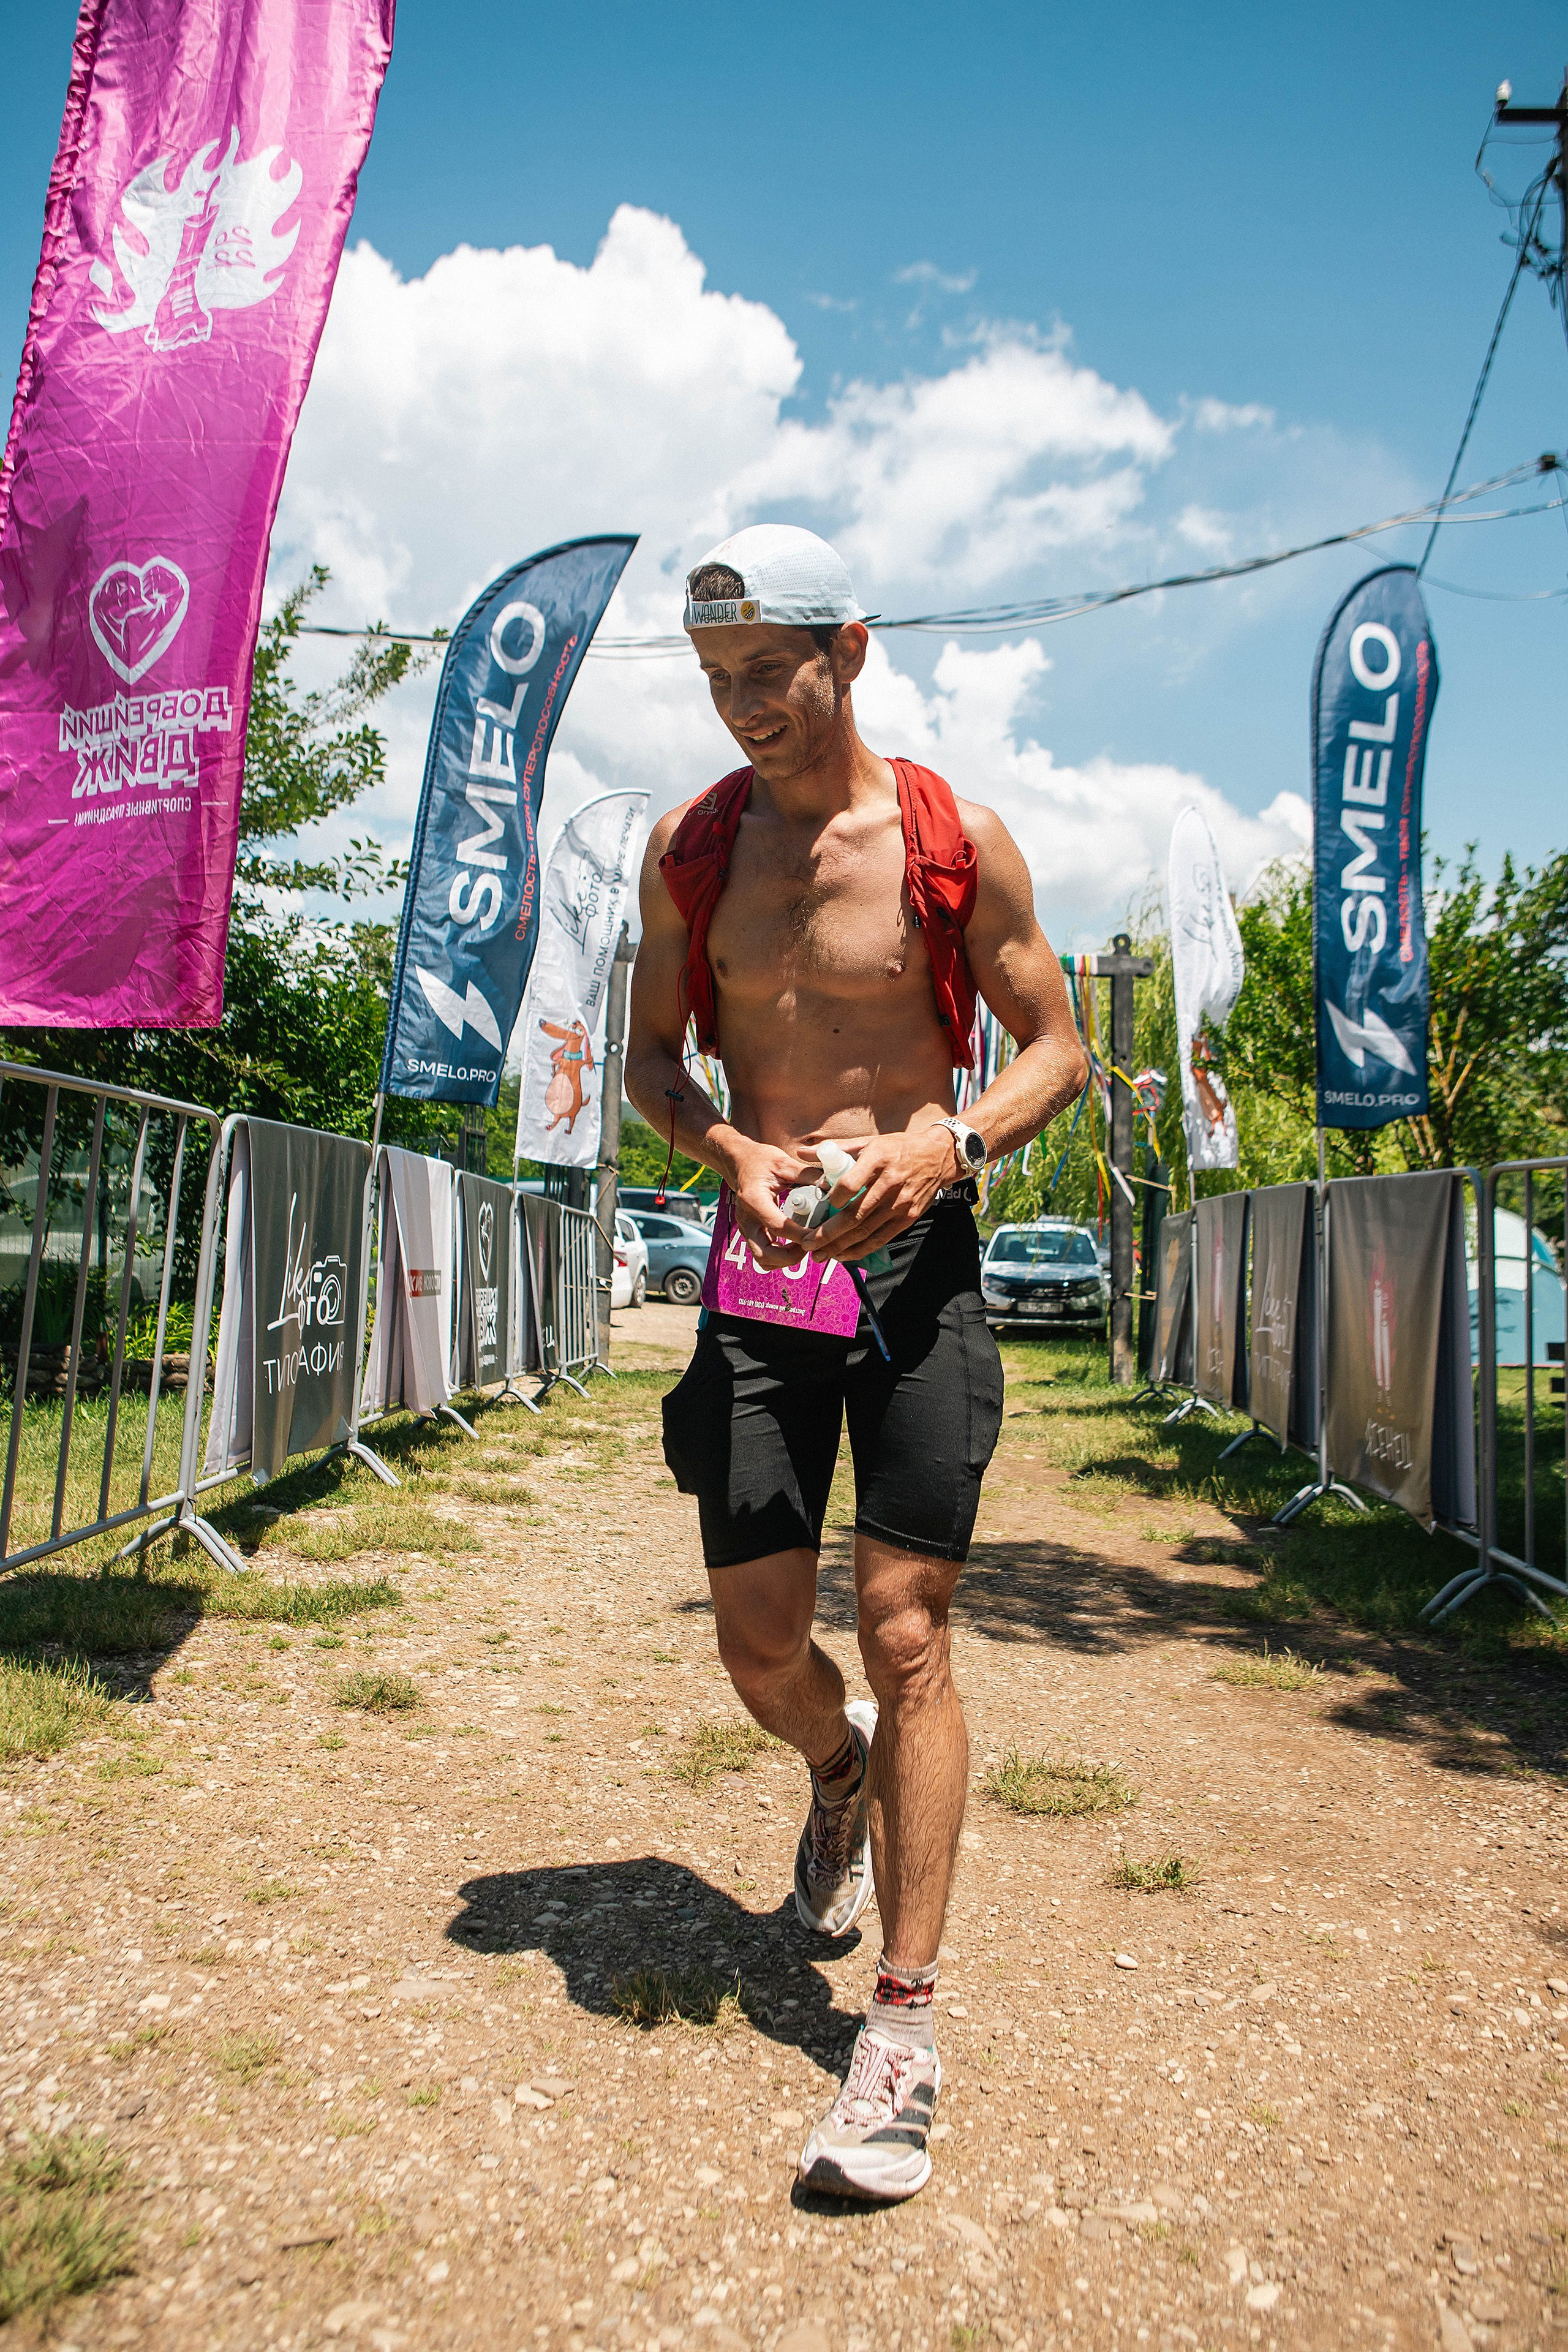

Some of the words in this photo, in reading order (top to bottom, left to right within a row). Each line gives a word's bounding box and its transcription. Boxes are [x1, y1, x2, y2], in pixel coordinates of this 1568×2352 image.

[693, 602, 737, 624] WONDER
[523, 635, 578, 801] СУПЕРСПОСОБНОСТЬ
[449, 601, 546, 931] SMELO
[1340, 621, 1401, 955] SMELO
[514, 850, 537, 941] СМЕЛОСТЬ
[593, 898, 620, 978] ПОМОЩНИК
[586, 980, 601, 1008] ВАШ
[407, 1058, 497, 1083] SMELO.PRO
[1324, 1090, 1421, 1107] SMELO.PRO
[779, 1305, 805, 1316] Экстреый
